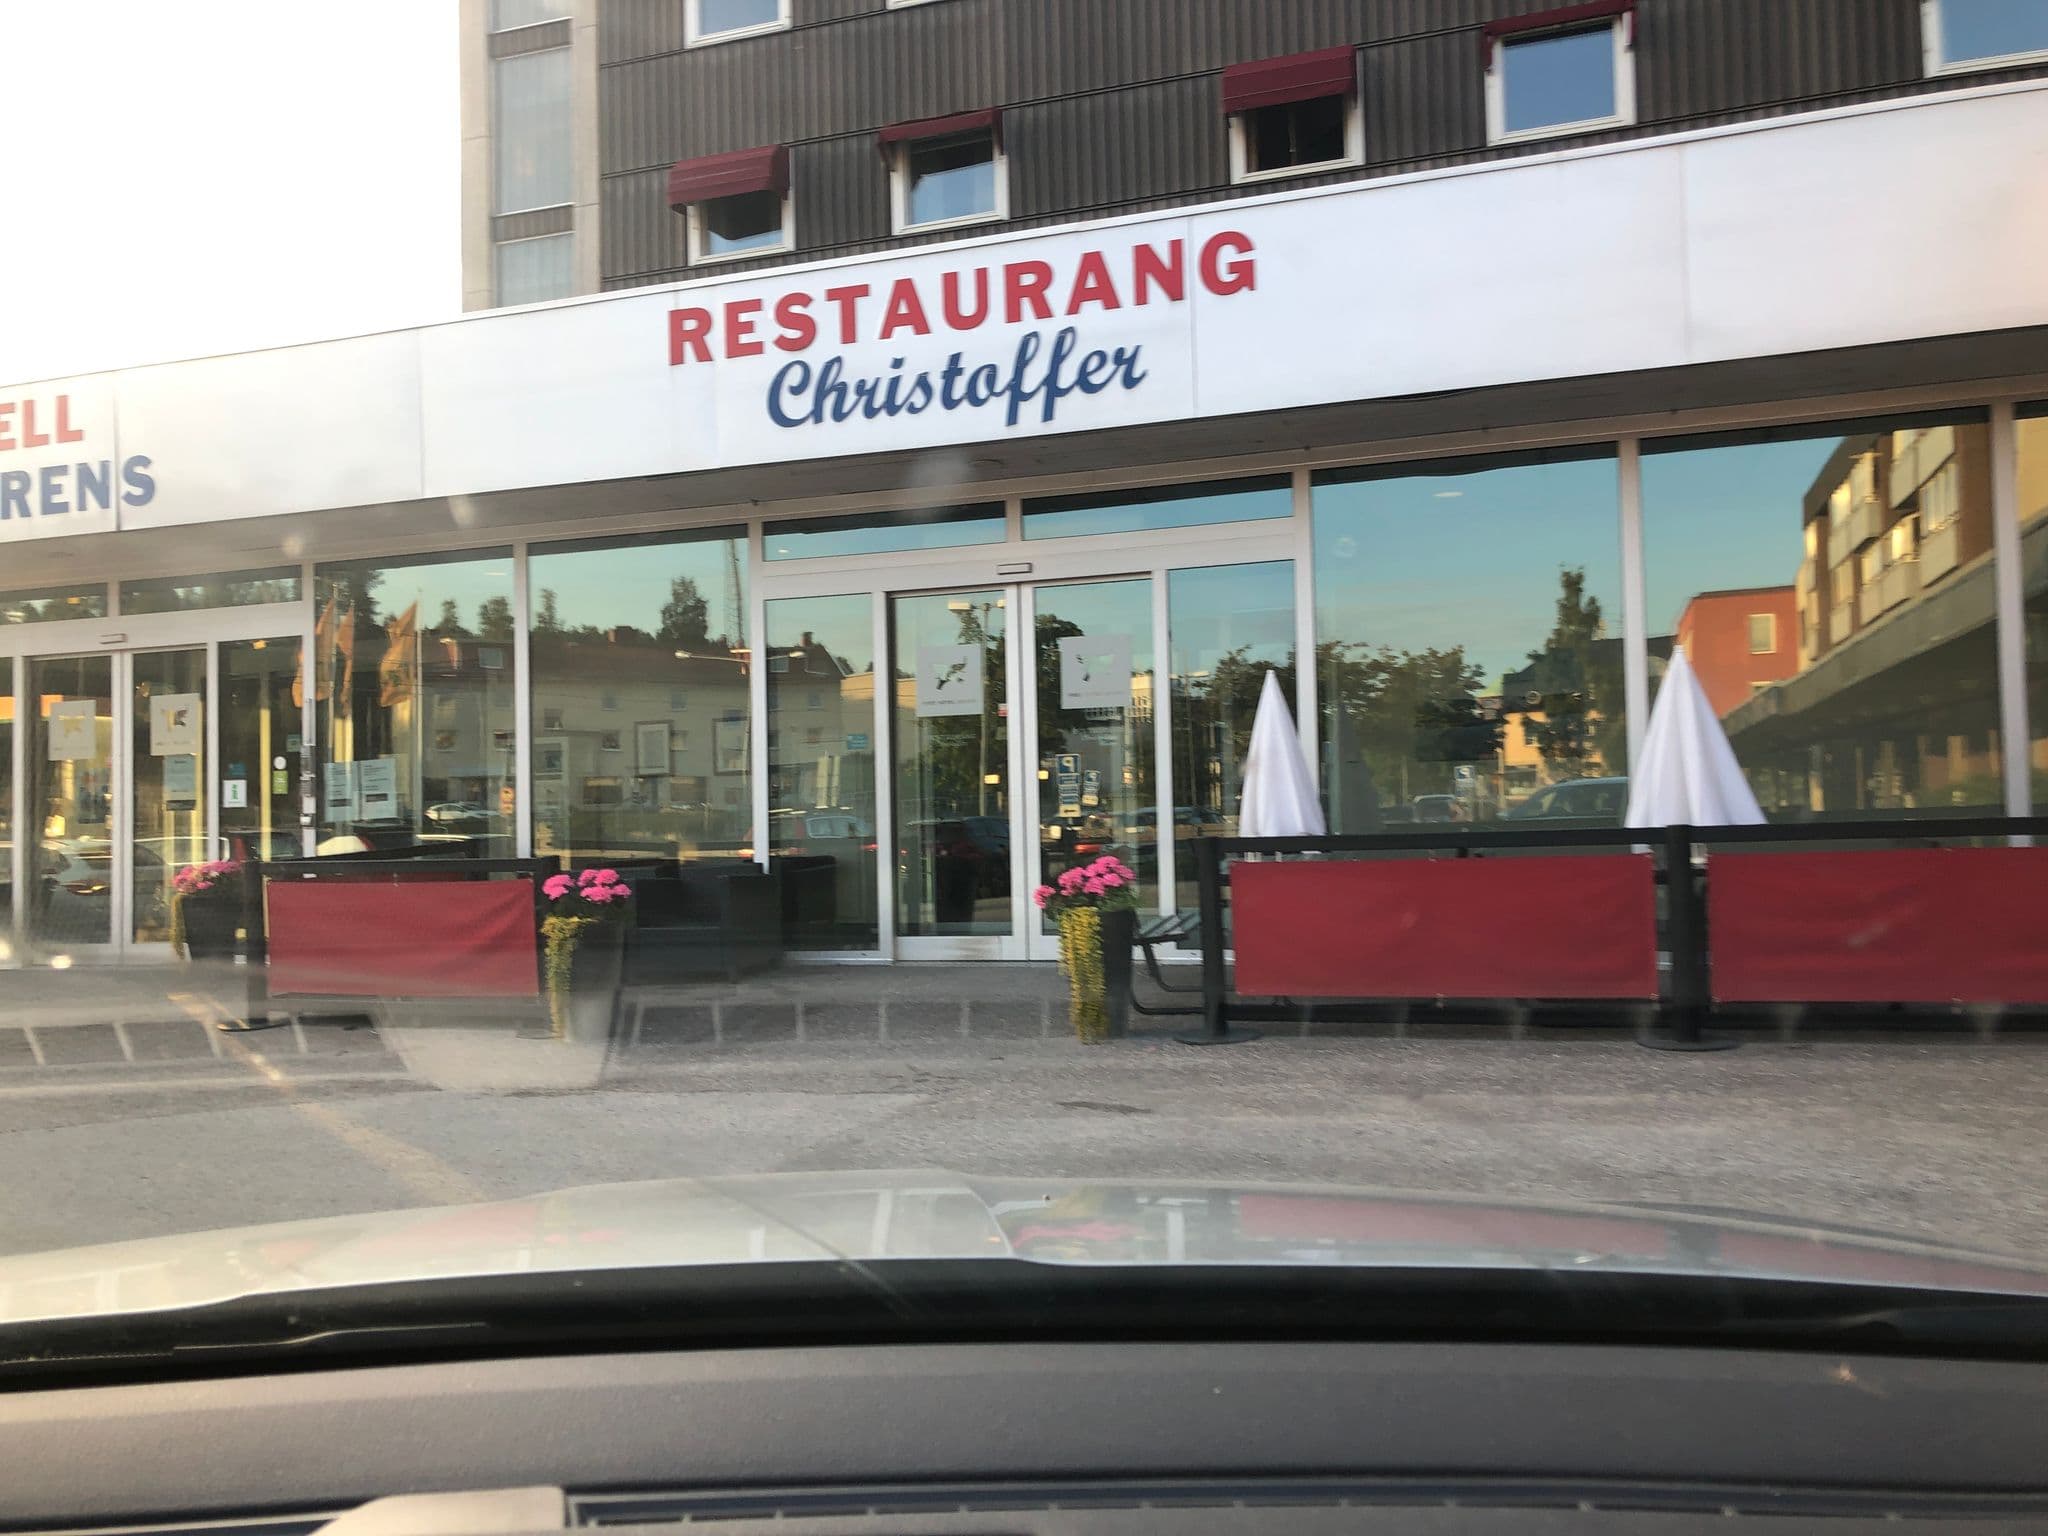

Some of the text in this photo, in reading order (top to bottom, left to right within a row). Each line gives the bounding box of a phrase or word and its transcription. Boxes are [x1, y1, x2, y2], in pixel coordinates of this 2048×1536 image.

[668, 230, 1256, 366] RESTAURANG
[767, 325, 1148, 428] Christoffer
[0, 455, 155, 520] RENS
